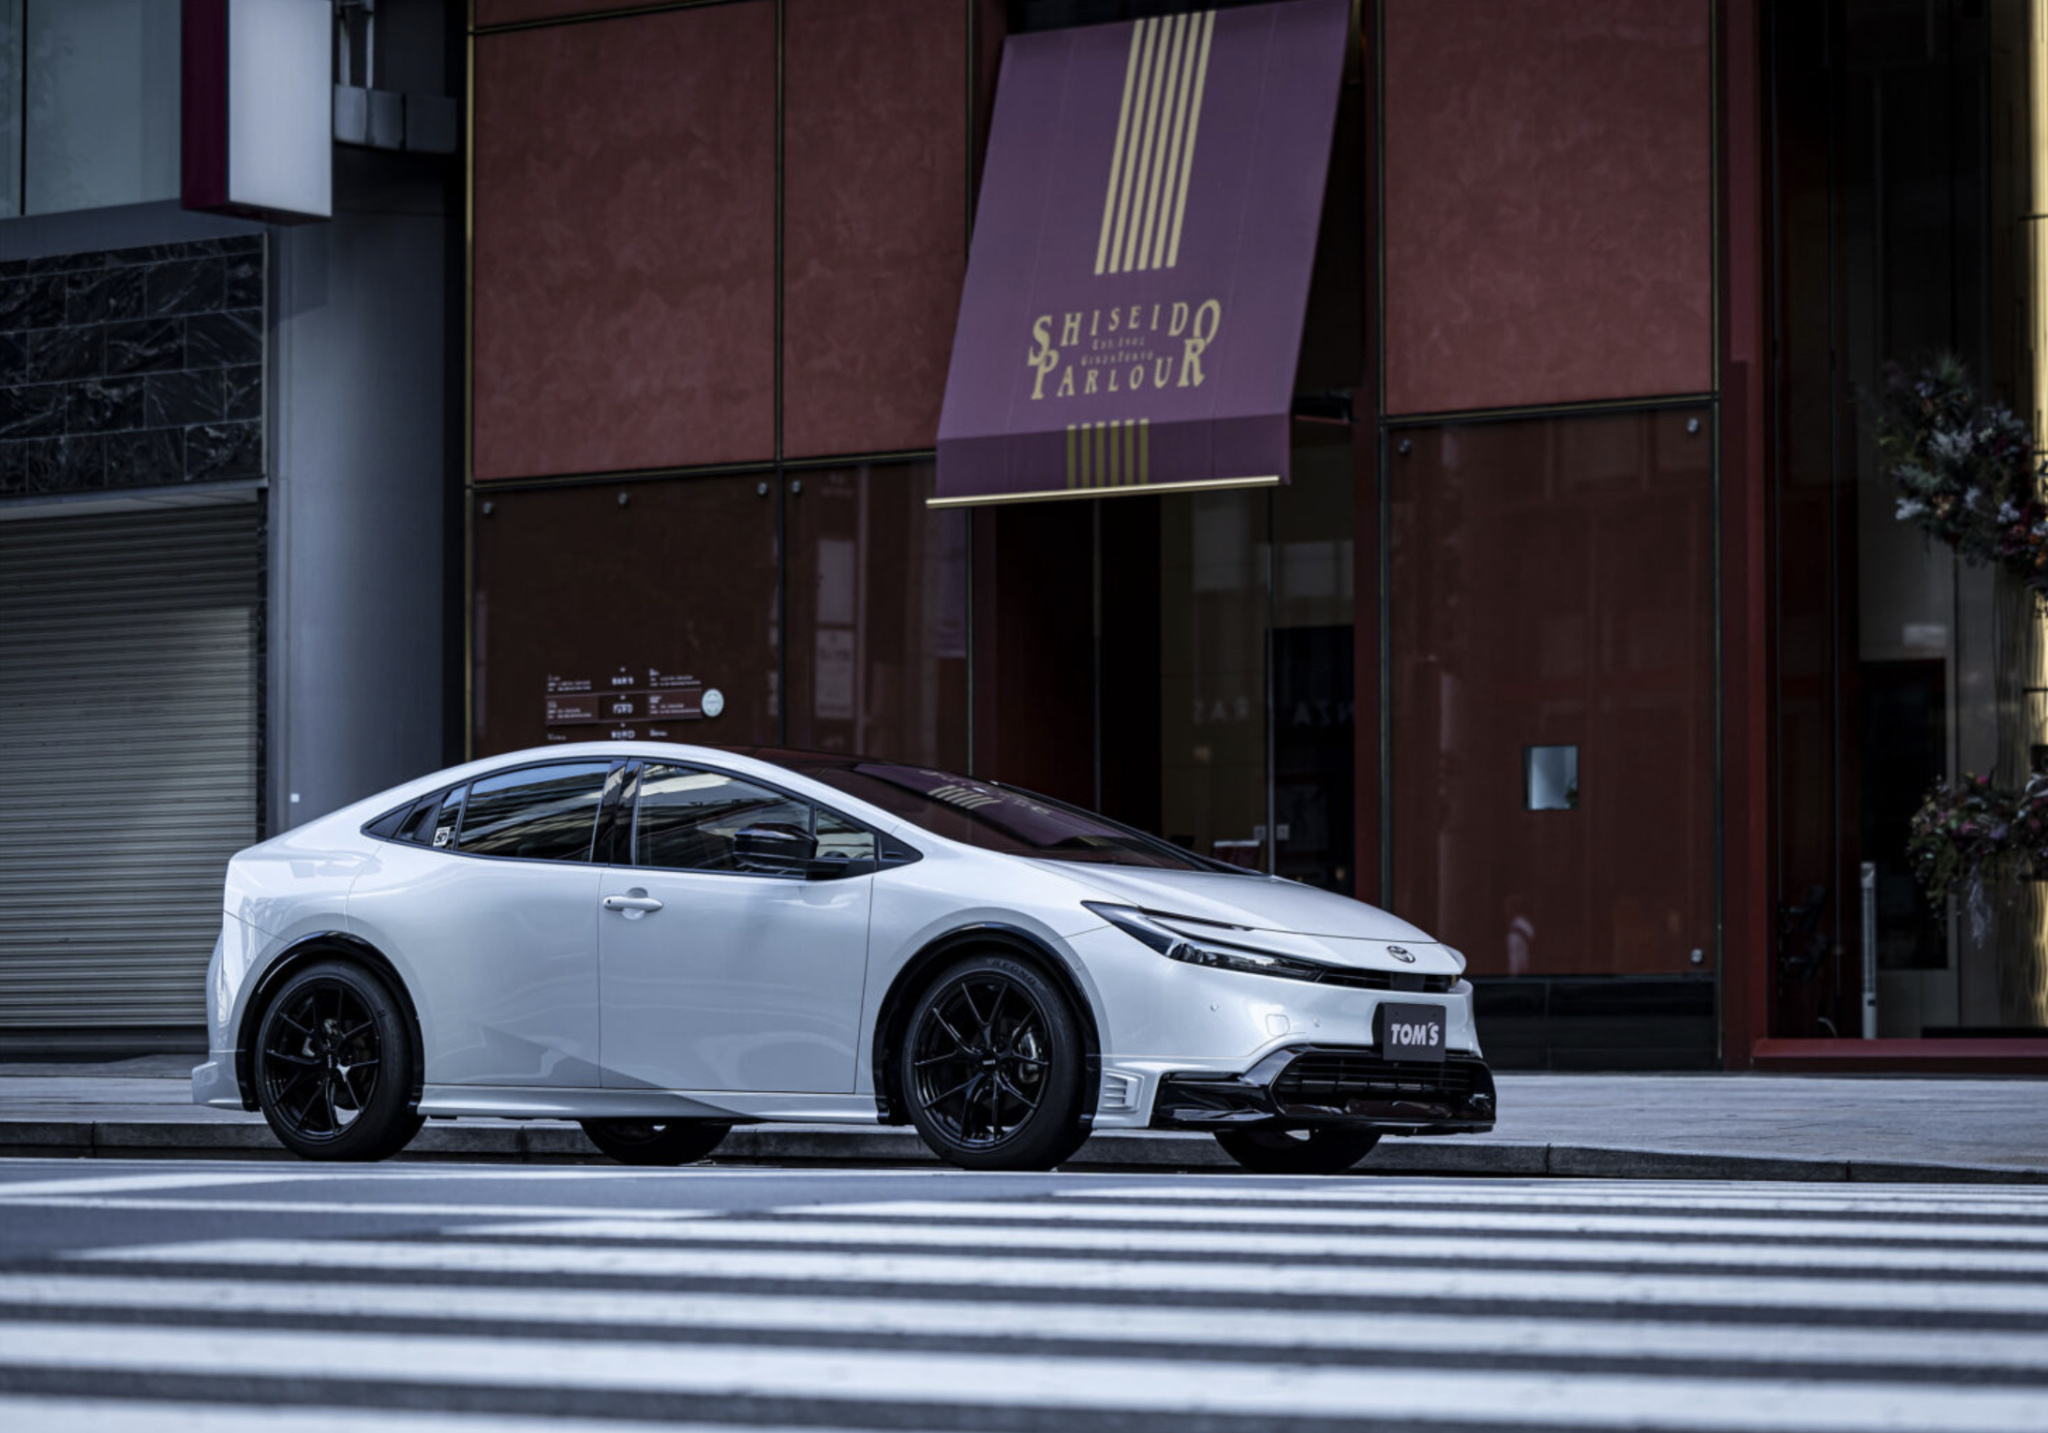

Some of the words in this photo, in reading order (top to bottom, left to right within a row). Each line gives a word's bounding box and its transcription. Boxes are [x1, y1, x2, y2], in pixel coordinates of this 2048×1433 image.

[1027, 299, 1221, 366] SHISEIDO
[1031, 338, 1205, 400] PARLOUR
[1391, 1022, 1439, 1046] TOM'S
